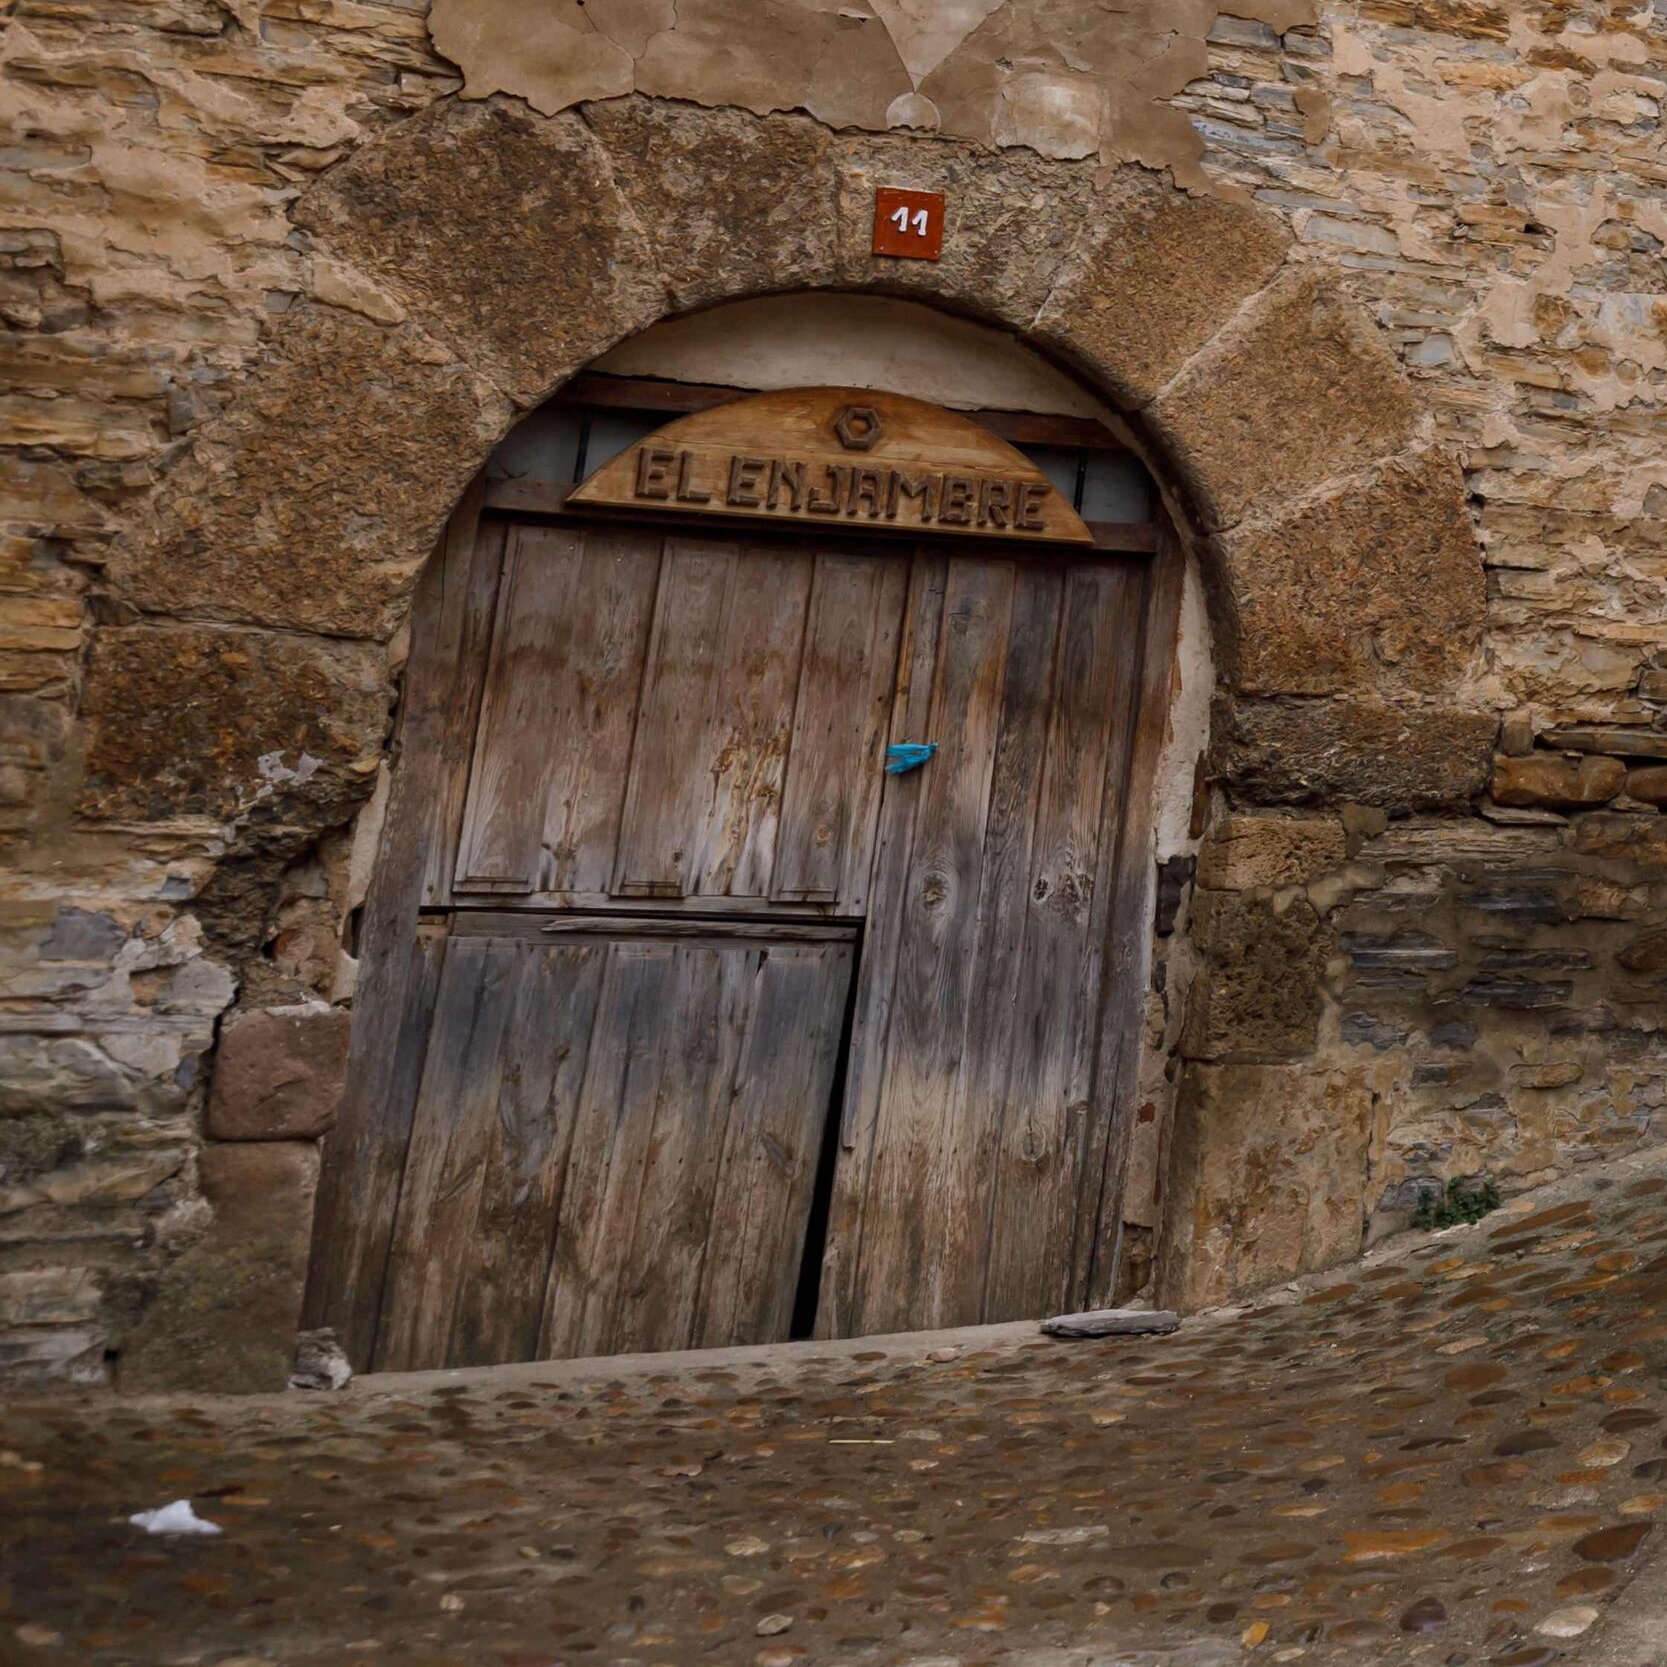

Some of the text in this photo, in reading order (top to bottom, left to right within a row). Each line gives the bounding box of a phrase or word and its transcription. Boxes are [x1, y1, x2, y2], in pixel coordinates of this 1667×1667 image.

[891, 206, 928, 236] 11
[635, 447, 1052, 531] EL ENJAMBRE
